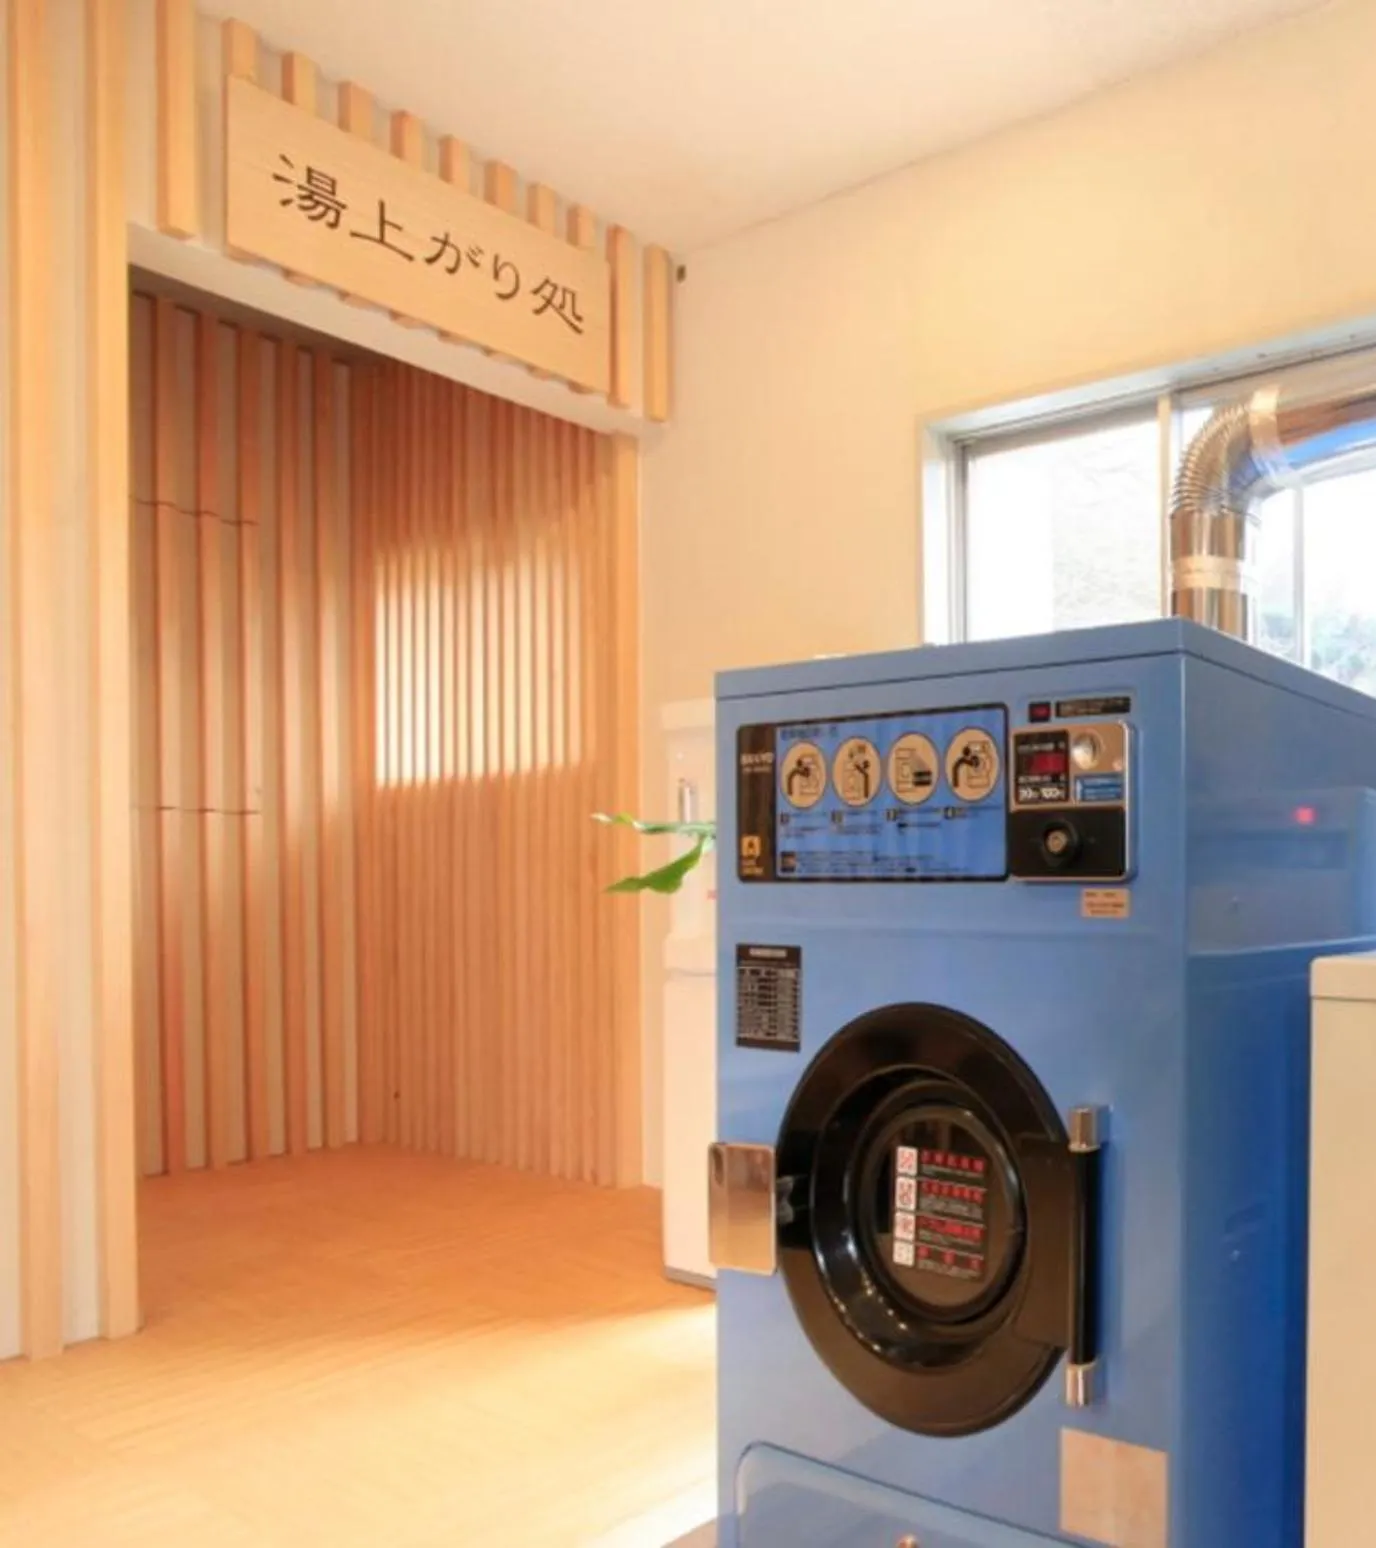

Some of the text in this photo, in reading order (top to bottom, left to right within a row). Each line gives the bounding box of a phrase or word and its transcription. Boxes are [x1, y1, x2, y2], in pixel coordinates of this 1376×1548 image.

[272, 153, 585, 335] 湯上がり処
